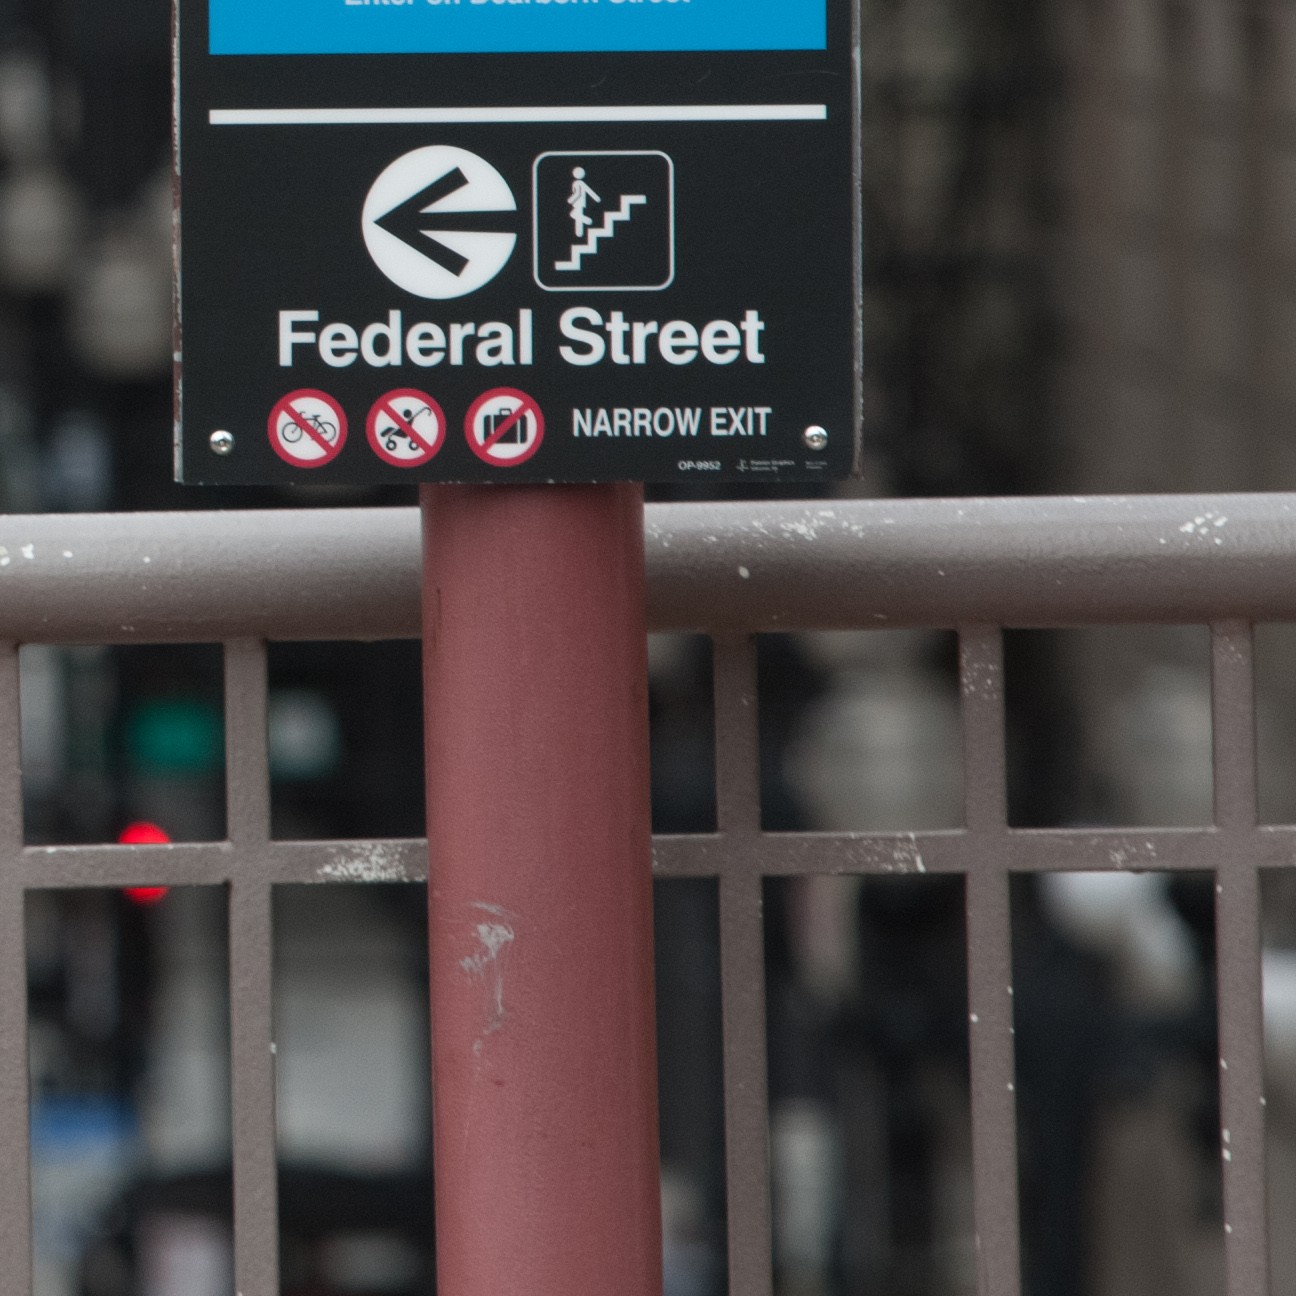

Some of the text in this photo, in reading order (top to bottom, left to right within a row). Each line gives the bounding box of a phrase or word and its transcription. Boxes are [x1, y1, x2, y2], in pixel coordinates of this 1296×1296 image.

[278, 306, 765, 368] Federal Street
[572, 406, 773, 437] NARROW EXIT
